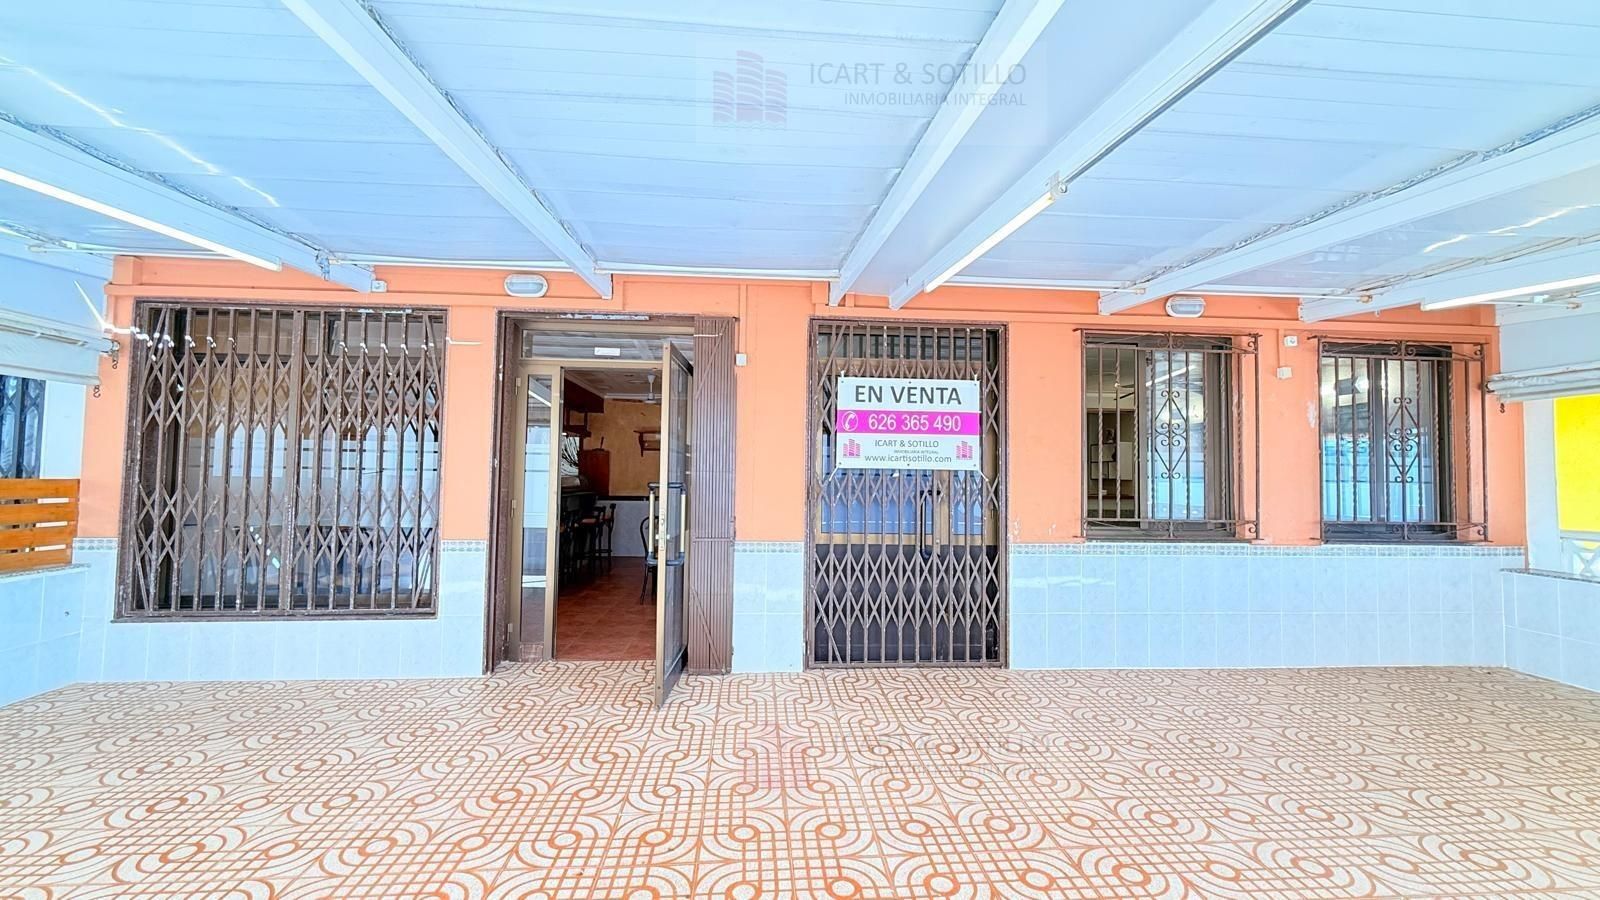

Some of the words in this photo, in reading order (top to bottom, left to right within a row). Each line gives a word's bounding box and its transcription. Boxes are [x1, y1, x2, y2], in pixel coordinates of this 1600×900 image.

[855, 385, 883, 403] EN
[891, 386, 962, 405] VENTA
[868, 413, 897, 430] 626
[901, 414, 929, 431] 365
[933, 415, 962, 432] 490
[875, 439, 897, 447] ICART
[907, 440, 939, 448] SOTILLO
[865, 454, 952, 463] www.icartisotillo.com
